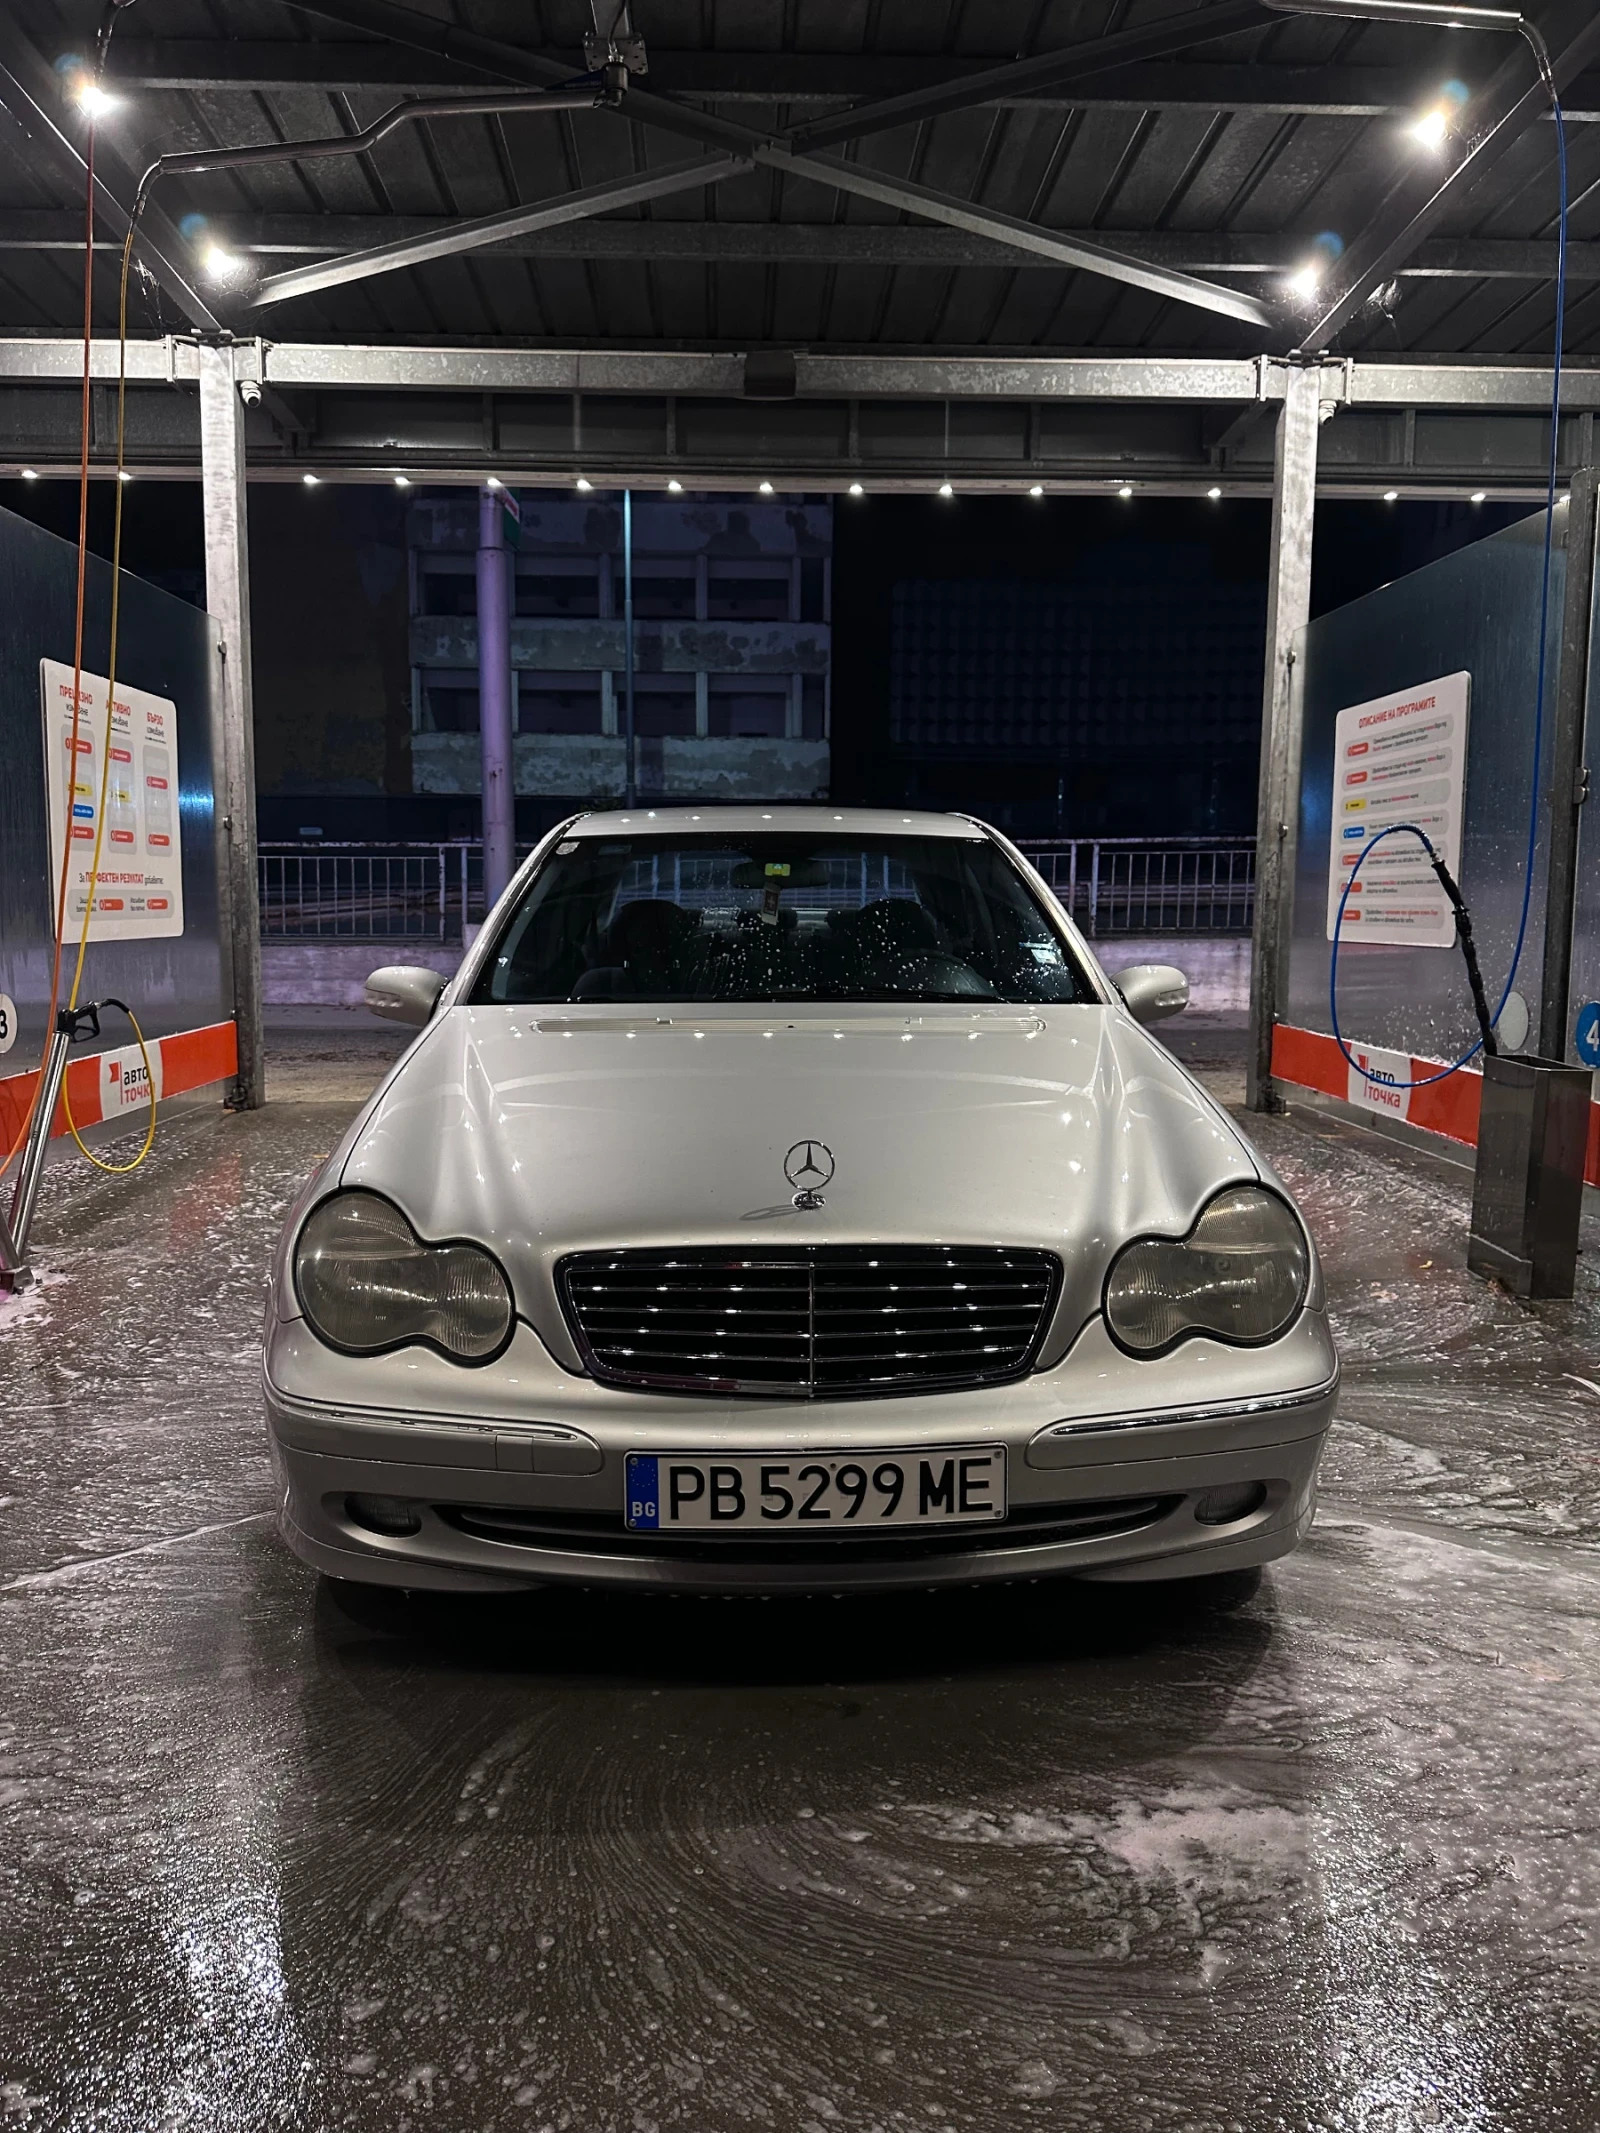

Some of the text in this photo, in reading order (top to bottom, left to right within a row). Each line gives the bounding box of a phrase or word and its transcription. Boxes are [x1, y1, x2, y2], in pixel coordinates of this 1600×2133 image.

[105, 700, 131, 716] АТИВНО
[1397, 696, 1436, 717] ПРОГРАМИТЕ
[146, 712, 164, 726] БЪРЗО
[85, 871, 119, 883] ПЕФЕКТЕН
[0, 1009, 8, 1039] 3
[1586, 1019, 1600, 1051] 4
[123, 1066, 149, 1085] авто
[1368, 1085, 1401, 1108] точка
[669, 1457, 993, 1520] PB 5299 ME
[632, 1502, 656, 1517] BG
